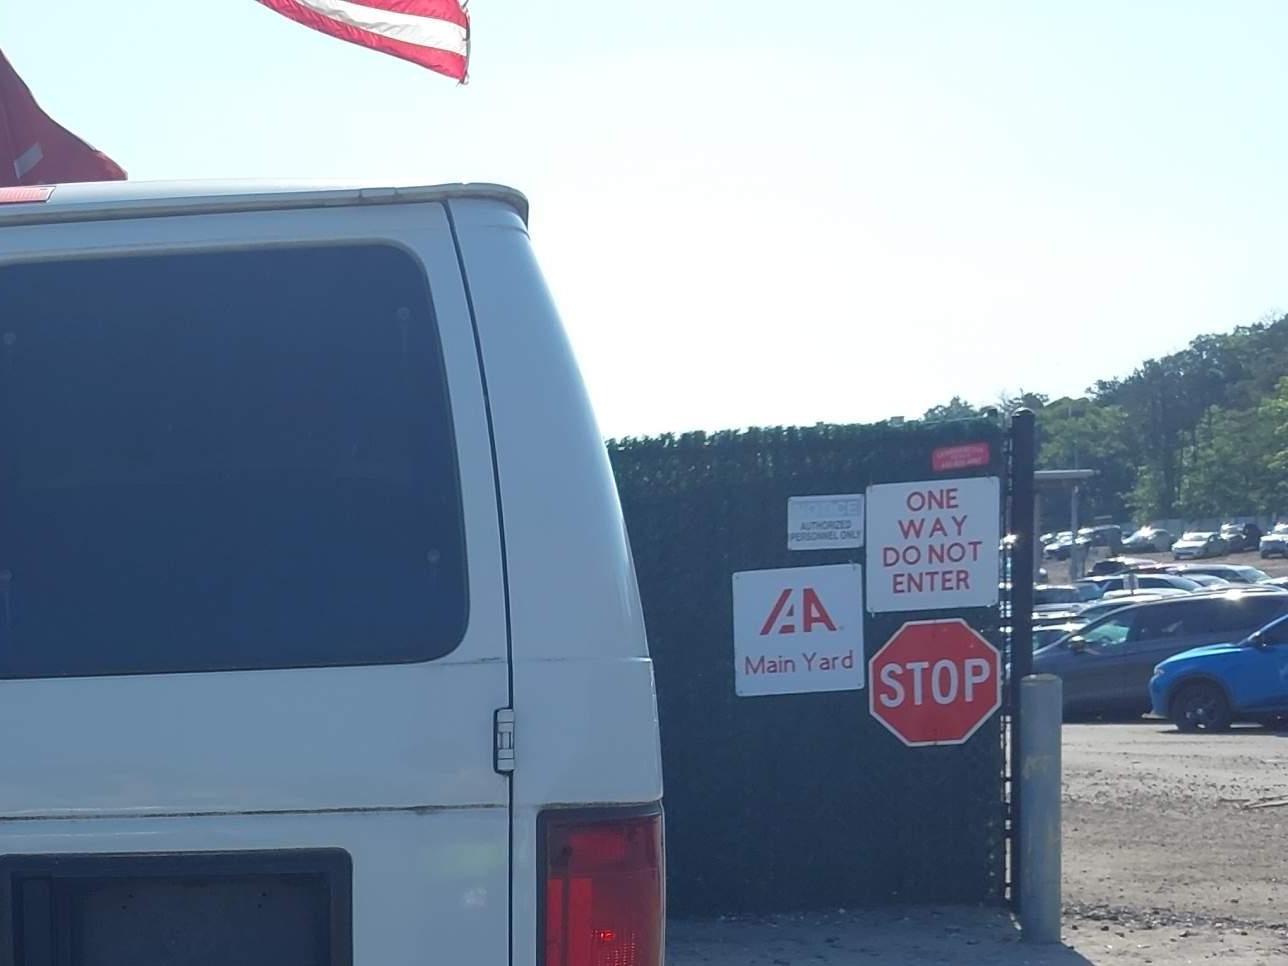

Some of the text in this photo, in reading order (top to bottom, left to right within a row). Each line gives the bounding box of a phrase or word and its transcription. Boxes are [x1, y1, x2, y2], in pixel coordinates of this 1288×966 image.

[906, 488, 959, 512] ONE
[898, 514, 968, 540] WAY
[882, 541, 983, 567] DO NOT
[893, 570, 970, 594] ENTER
[744, 649, 854, 676] Main Yard
[879, 657, 991, 709] STOP
